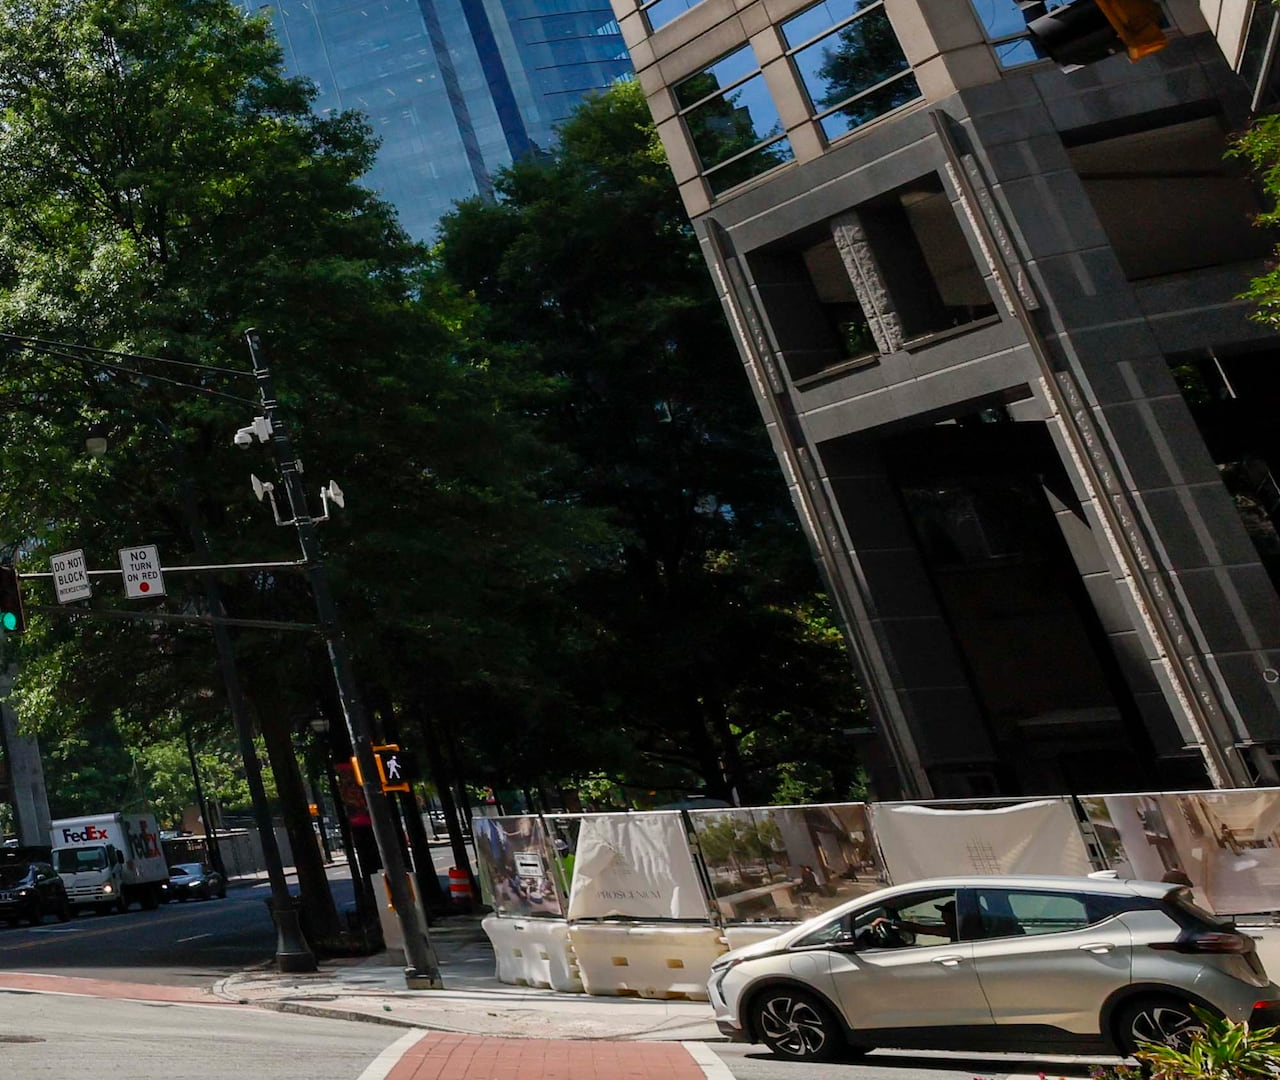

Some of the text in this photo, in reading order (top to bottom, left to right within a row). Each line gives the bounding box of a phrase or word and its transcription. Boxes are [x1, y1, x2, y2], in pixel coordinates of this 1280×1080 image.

[130, 551, 147, 562] NO
[54, 557, 83, 572] DO NOT
[130, 561, 152, 572] TURN
[58, 571, 85, 585] BLOCK
[128, 571, 158, 582] ON RED
[62, 824, 108, 843] FedEx
